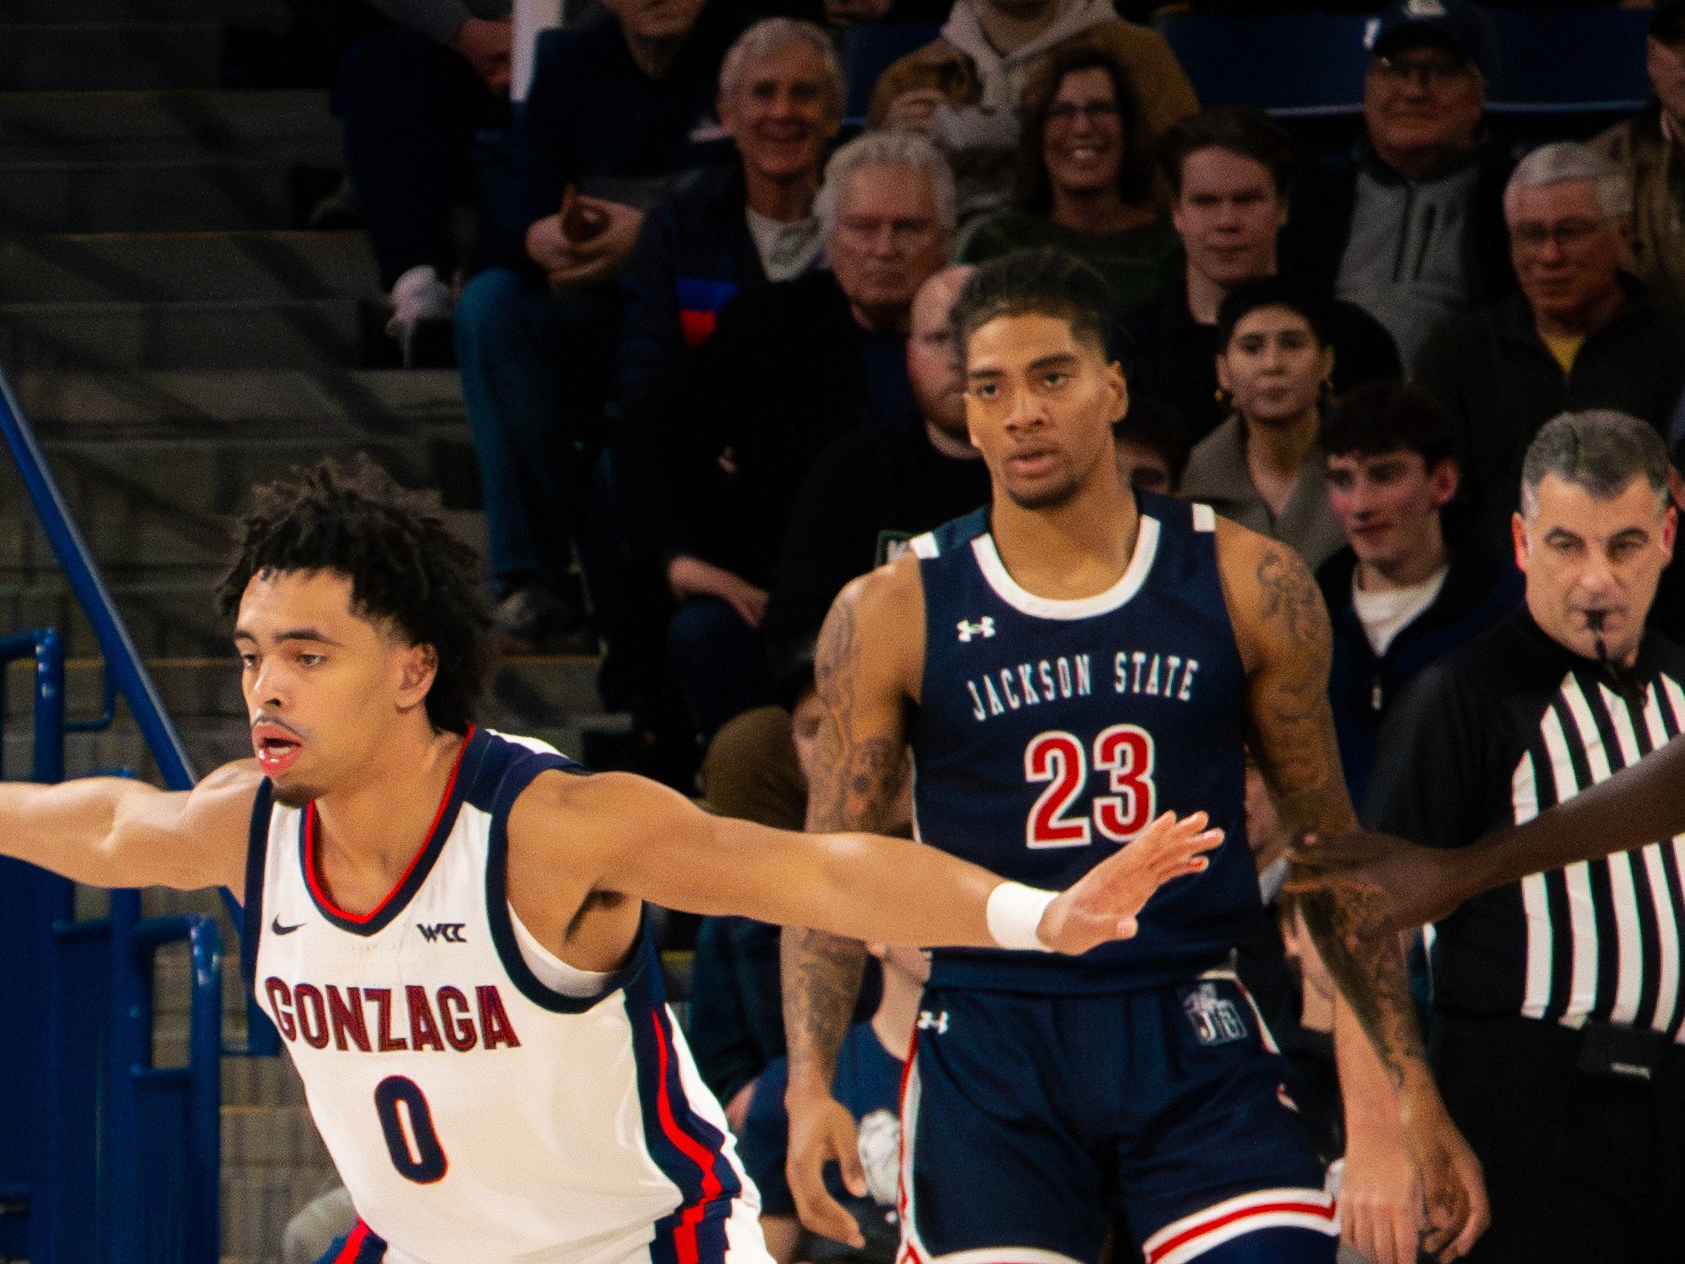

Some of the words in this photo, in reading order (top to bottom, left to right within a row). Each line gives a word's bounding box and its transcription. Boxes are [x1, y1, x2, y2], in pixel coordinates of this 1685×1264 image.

[967, 655, 1091, 722] JACKSON
[1114, 651, 1199, 702] STATE
[1025, 725, 1157, 849] 23
[417, 923, 467, 943] WCC
[265, 976, 521, 1052] GONZAGA
[374, 1075, 448, 1183] 0
